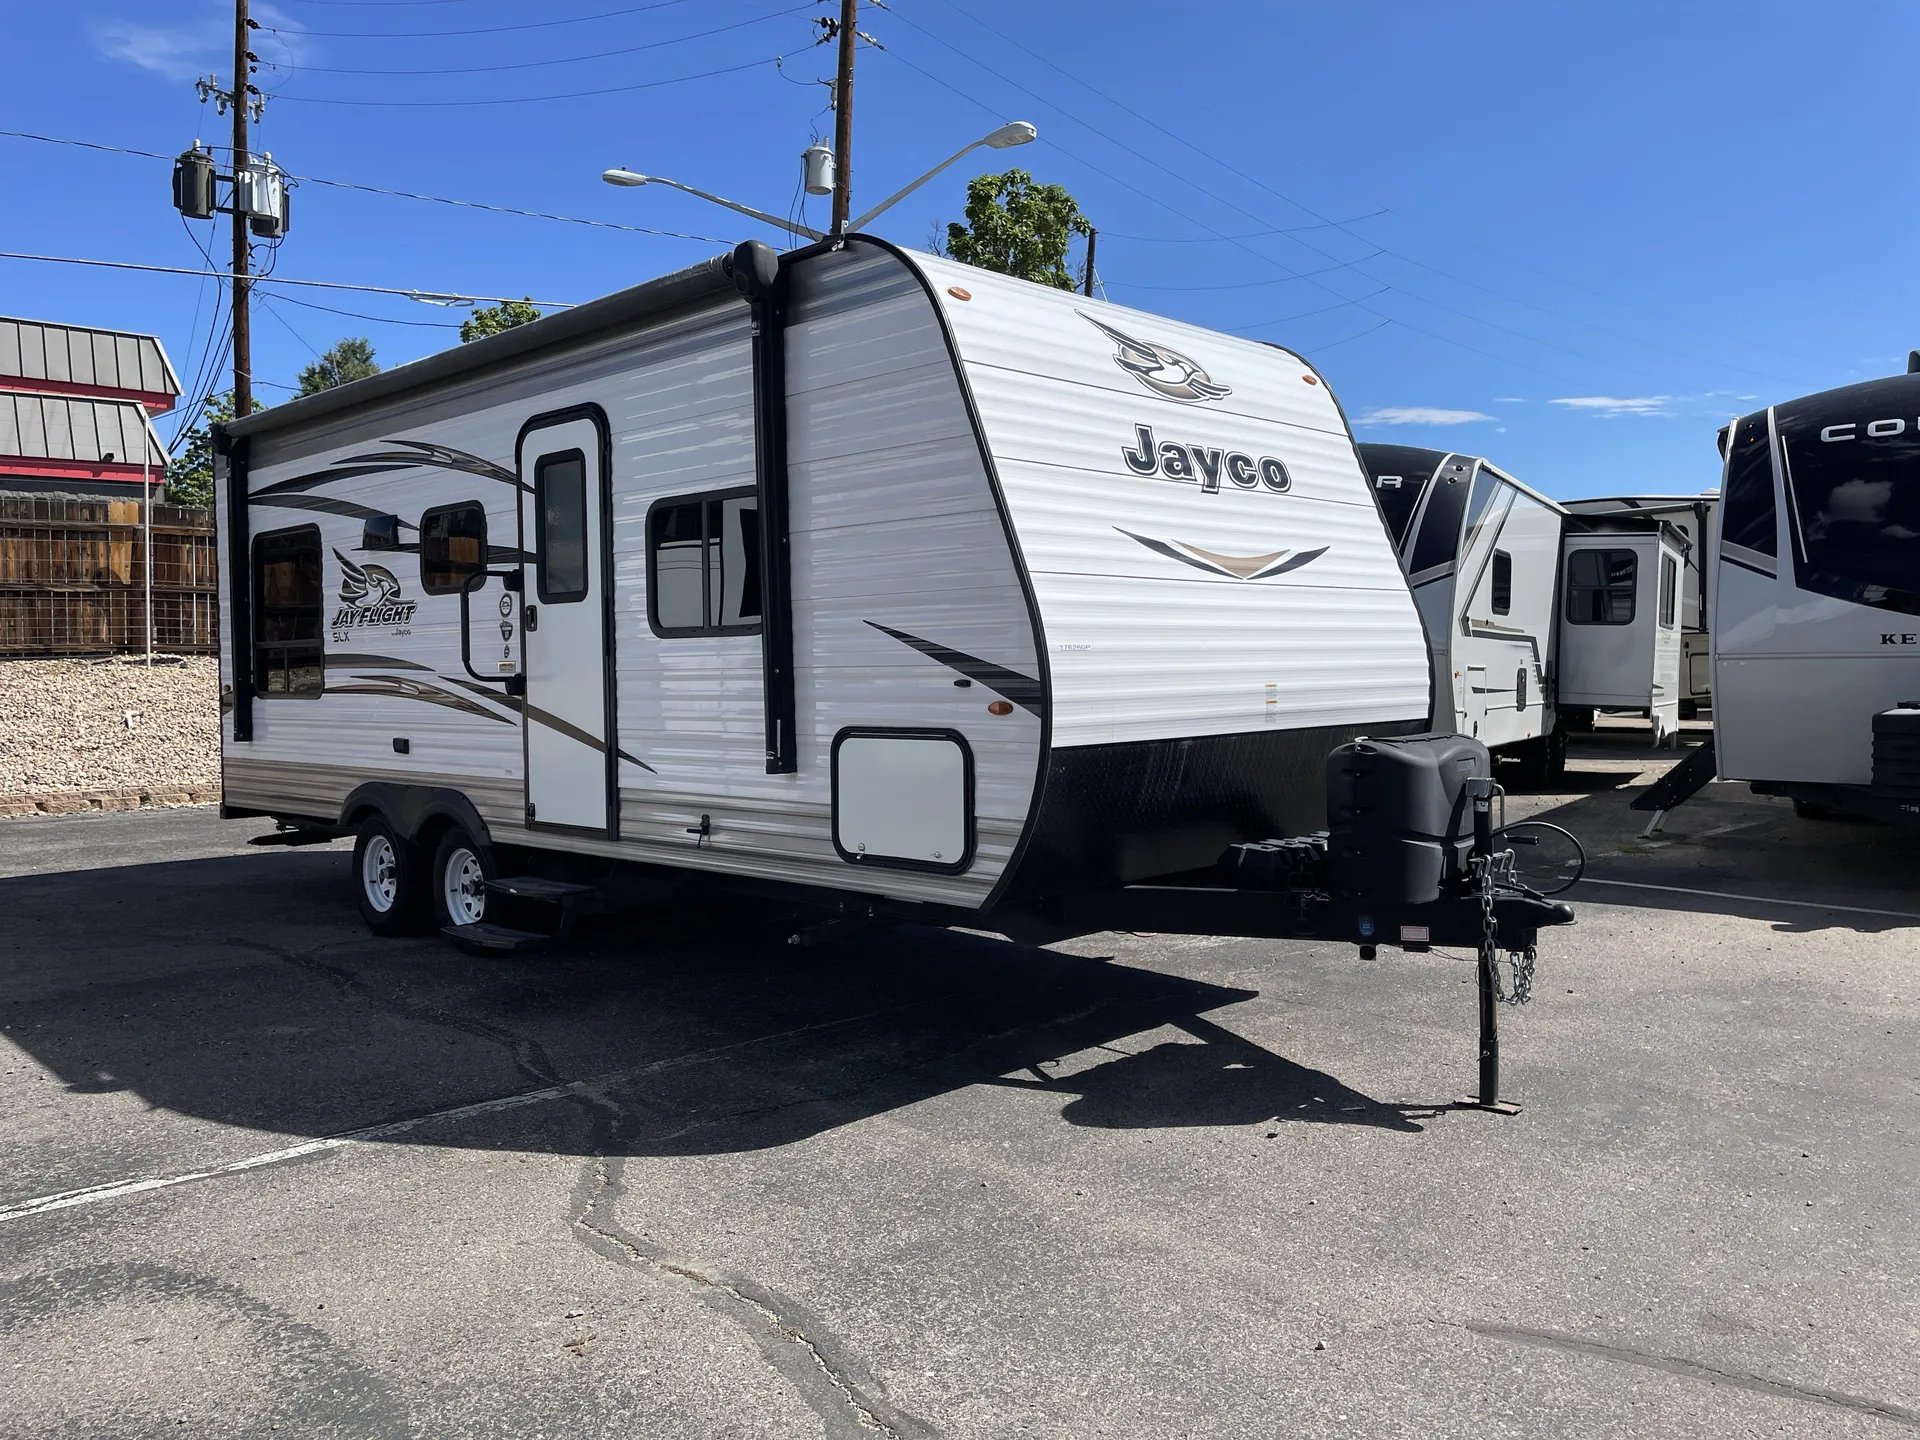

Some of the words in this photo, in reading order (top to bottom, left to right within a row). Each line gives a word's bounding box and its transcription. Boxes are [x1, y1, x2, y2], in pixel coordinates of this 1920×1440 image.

[1821, 416, 1920, 442] CO
[1121, 423, 1292, 495] Jayco
[331, 607, 361, 629] JAY
[357, 603, 418, 627] FLIGHT
[333, 631, 350, 643] SLX
[394, 628, 412, 637] Jayco
[1880, 633, 1917, 645] KE
